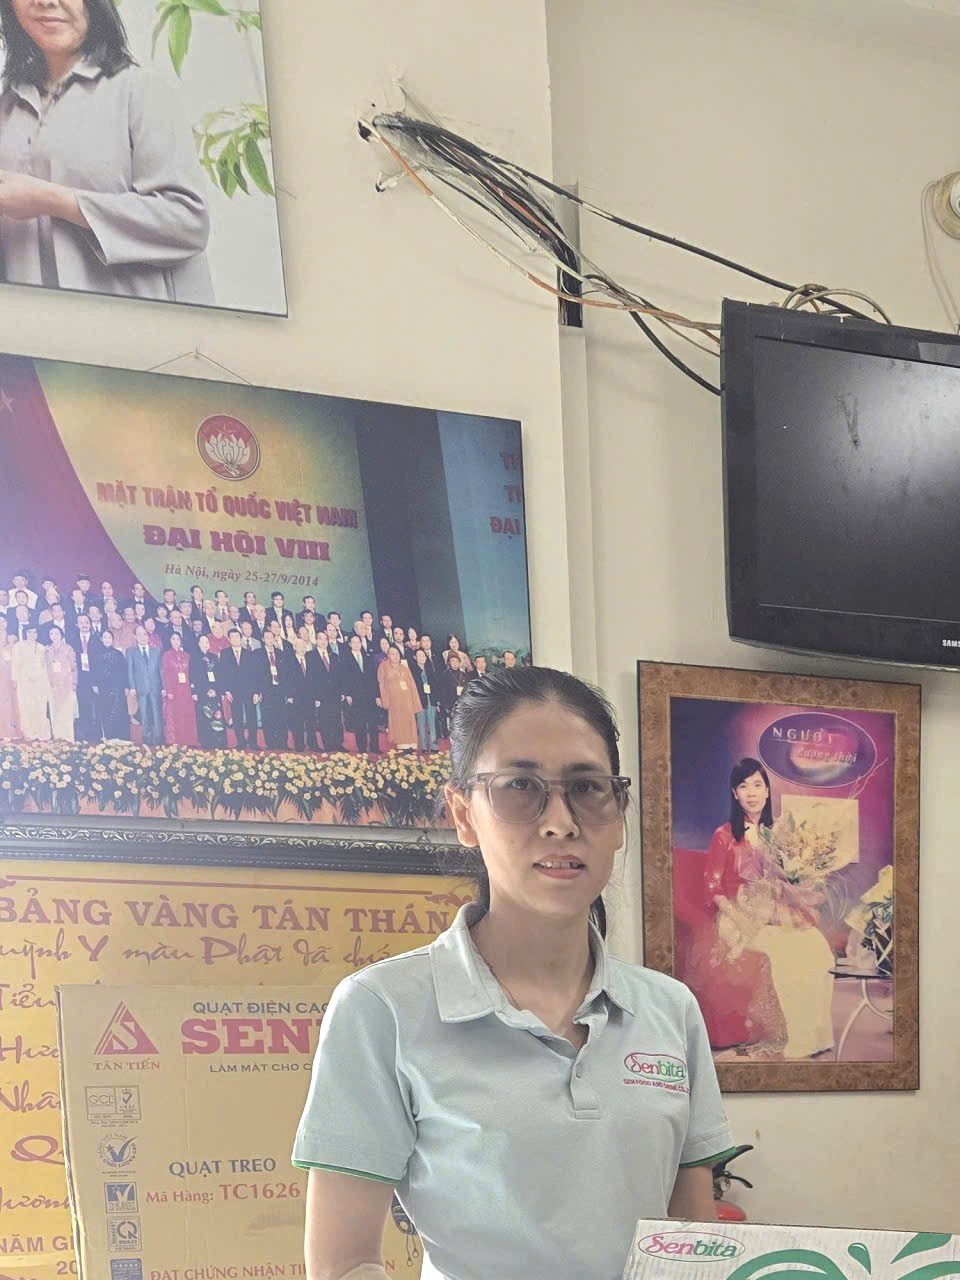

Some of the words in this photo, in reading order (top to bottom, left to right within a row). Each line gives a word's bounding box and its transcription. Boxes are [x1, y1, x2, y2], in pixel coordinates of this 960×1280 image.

[143, 485, 192, 514] TRẬN
[195, 486, 218, 513] TỔ
[222, 491, 271, 519] QUỐC
[274, 498, 312, 527] VIỆT
[316, 504, 358, 529] NAM
[144, 524, 202, 550] ĐẠI
[210, 529, 267, 558] HỘI
[274, 537, 330, 561] VIII
[164, 563, 182, 576] Hà
[185, 565, 209, 580] Nội,
[212, 568, 241, 583] ngày
[0, 887, 112, 926] BẢNG
[125, 894, 239, 929] VÀNG
[252, 898, 331, 932] TÁN
[193, 1001, 243, 1016] QUẠT
[247, 1000, 291, 1016] ĐIỆN
[181, 1018, 323, 1056] SEN
[125, 1058, 160, 1071] TIẾN
[210, 1061, 237, 1073] LÀM
[272, 1063, 299, 1072] CHO
[630, 1055, 684, 1077] Senbita
[169, 1160, 221, 1178] QUẠT
[229, 1158, 276, 1173] TREO
[147, 1191, 167, 1203] Mã
[173, 1189, 213, 1204] Hàng:
[219, 1182, 301, 1200] TC1626
[643, 1235, 737, 1259] Senbita
[242, 1262, 285, 1280] NHẬN
